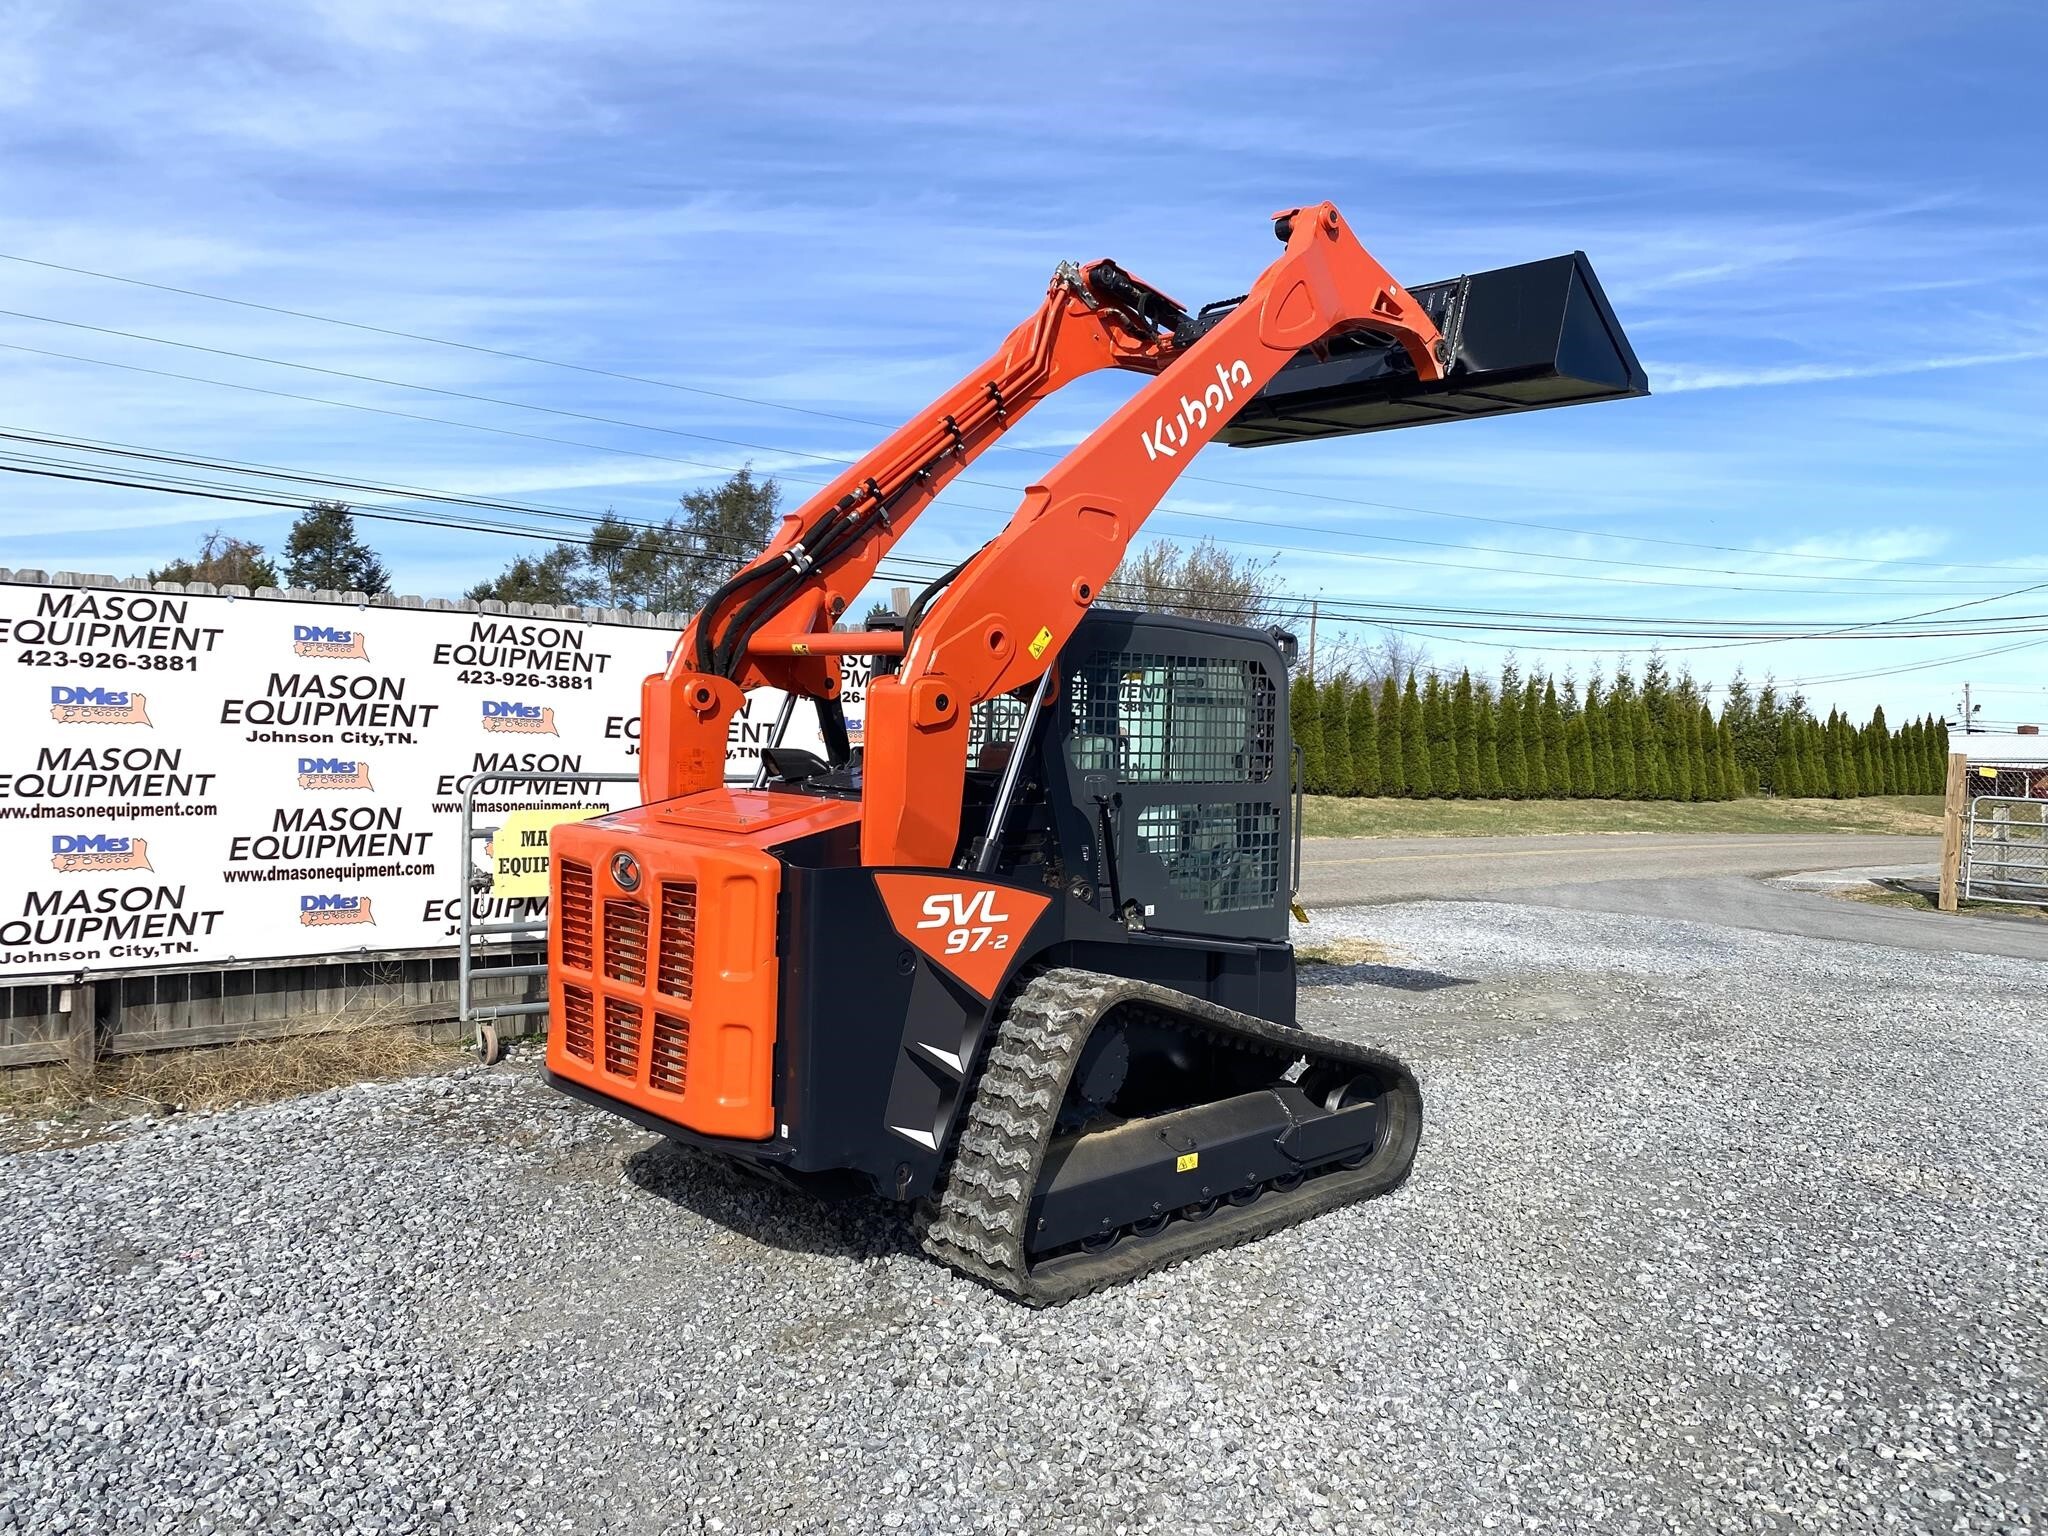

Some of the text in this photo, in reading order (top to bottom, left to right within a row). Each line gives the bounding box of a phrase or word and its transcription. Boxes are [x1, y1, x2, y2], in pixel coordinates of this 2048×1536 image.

[1141, 360, 1253, 461] Kubota
[37, 593, 188, 624] MASON
[470, 622, 583, 649] MASON
[18, 650, 197, 671] 423-926-3881
[433, 643, 611, 673] EQUIPMENT
[266, 673, 405, 700] MASON
[457, 670, 593, 690] 423-926-3881
[220, 699, 439, 727] EQUIPMENT
[246, 731, 418, 746] Johnson City,TN.
[37, 748, 182, 771] MASON
[472, 753, 582, 773] MASON
[273, 807, 402, 832] MASON
[229, 832, 433, 861] EQUIPMENT
[223, 863, 435, 882] www.dmasonequipment.com
[498, 857, 550, 878] EQUIP
[23, 885, 186, 917] MASON
[916, 890, 1009, 929] SVL
[0, 941, 198, 964] Johnson City,TN.
[944, 926, 1009, 955] 97-2
